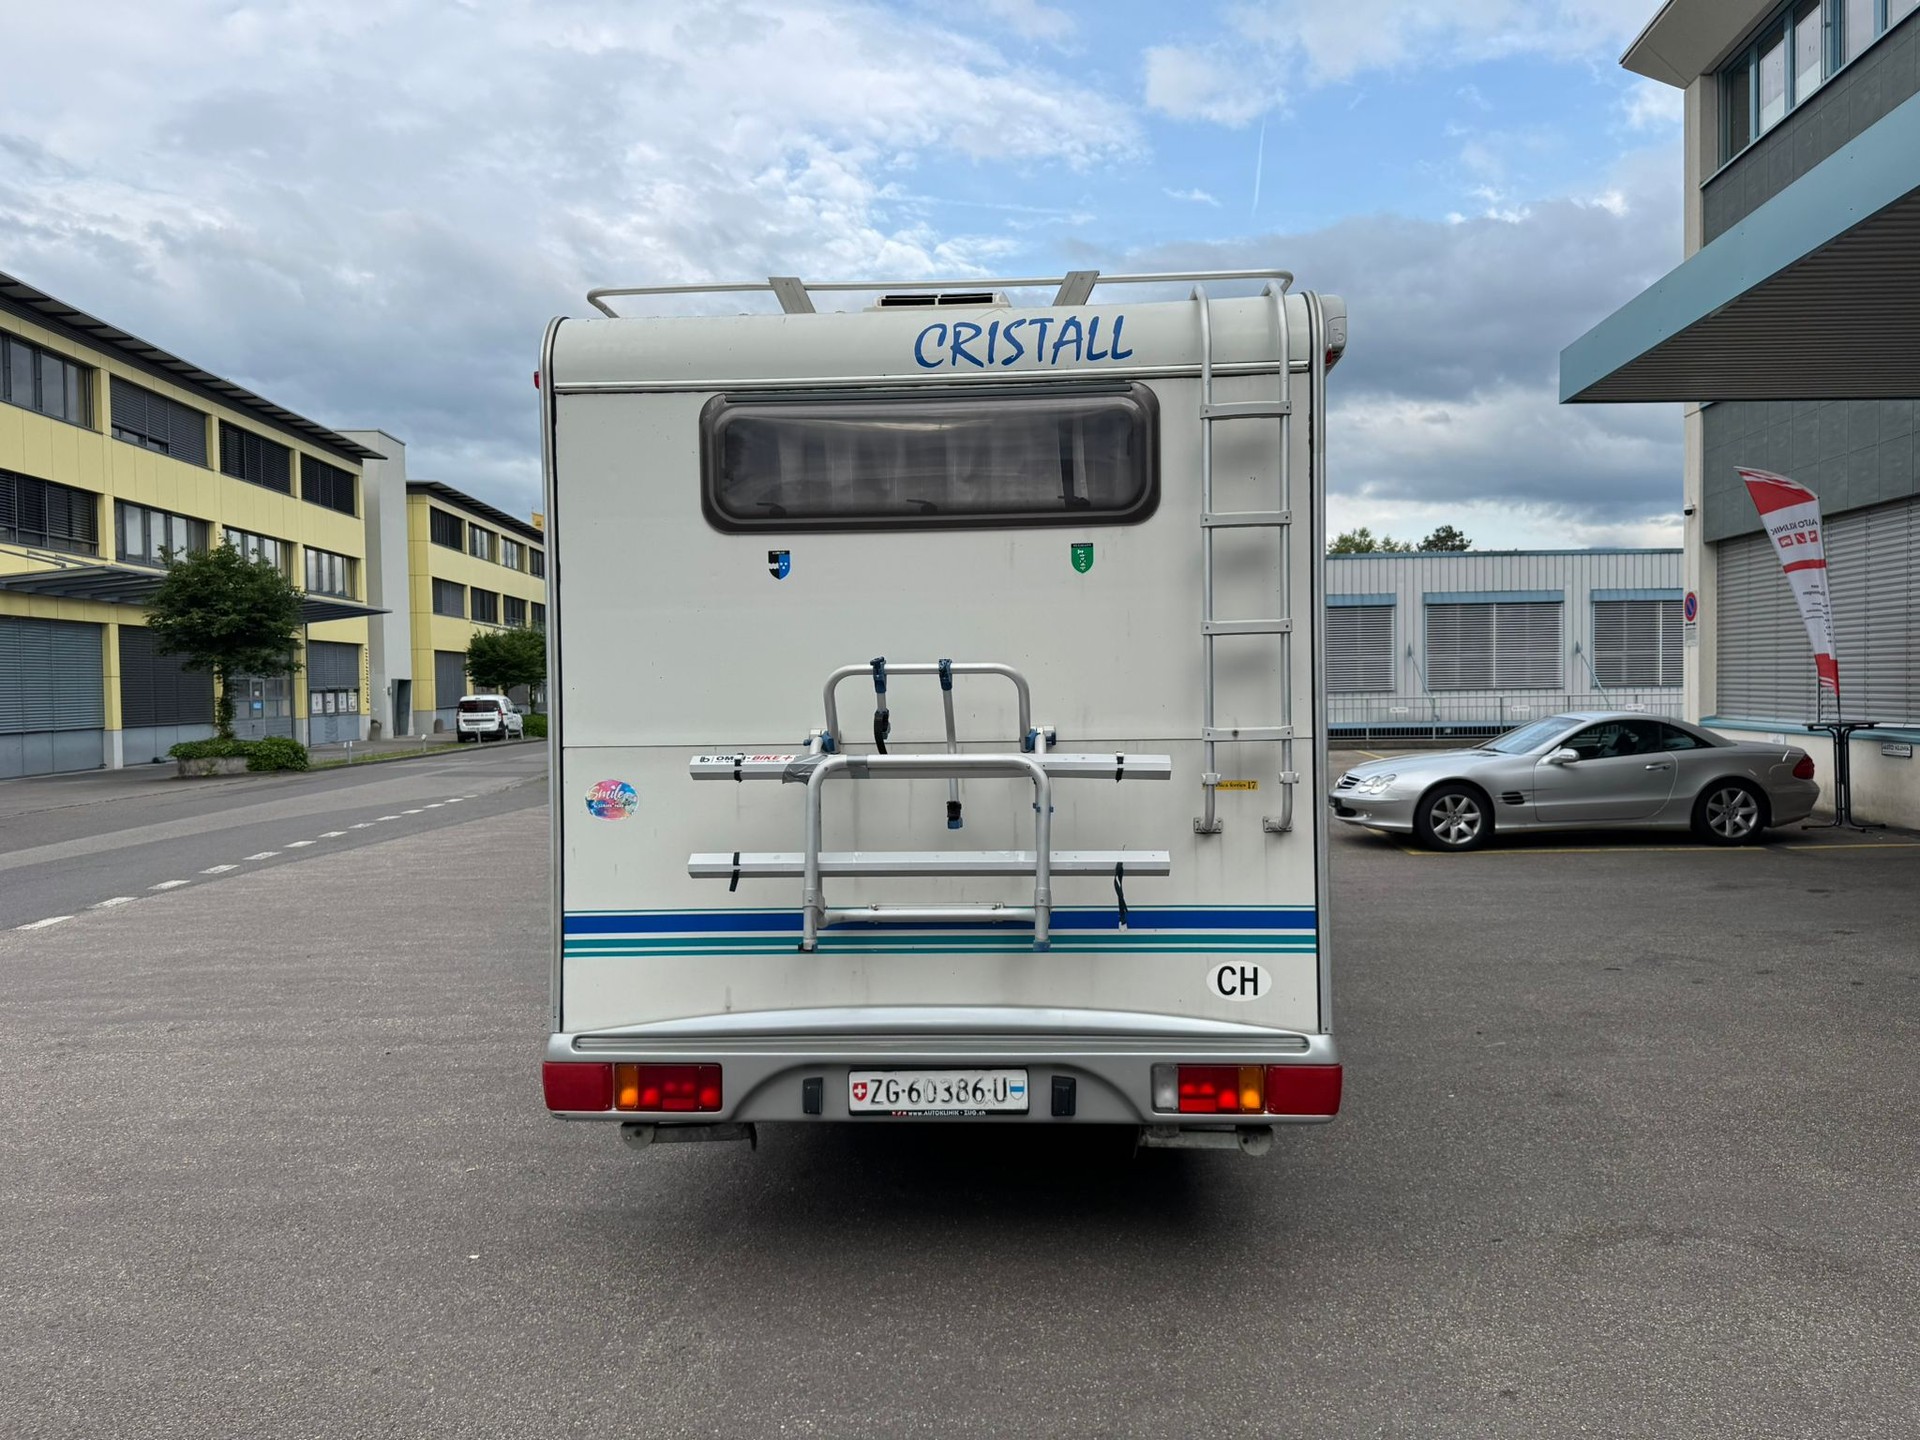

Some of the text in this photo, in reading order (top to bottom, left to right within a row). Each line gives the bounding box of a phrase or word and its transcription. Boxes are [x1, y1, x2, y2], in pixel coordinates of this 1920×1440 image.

[914, 315, 1133, 368] CRISTALL
[589, 783, 624, 801] Smile
[1247, 780, 1257, 790] 17
[1217, 965, 1258, 996] CH
